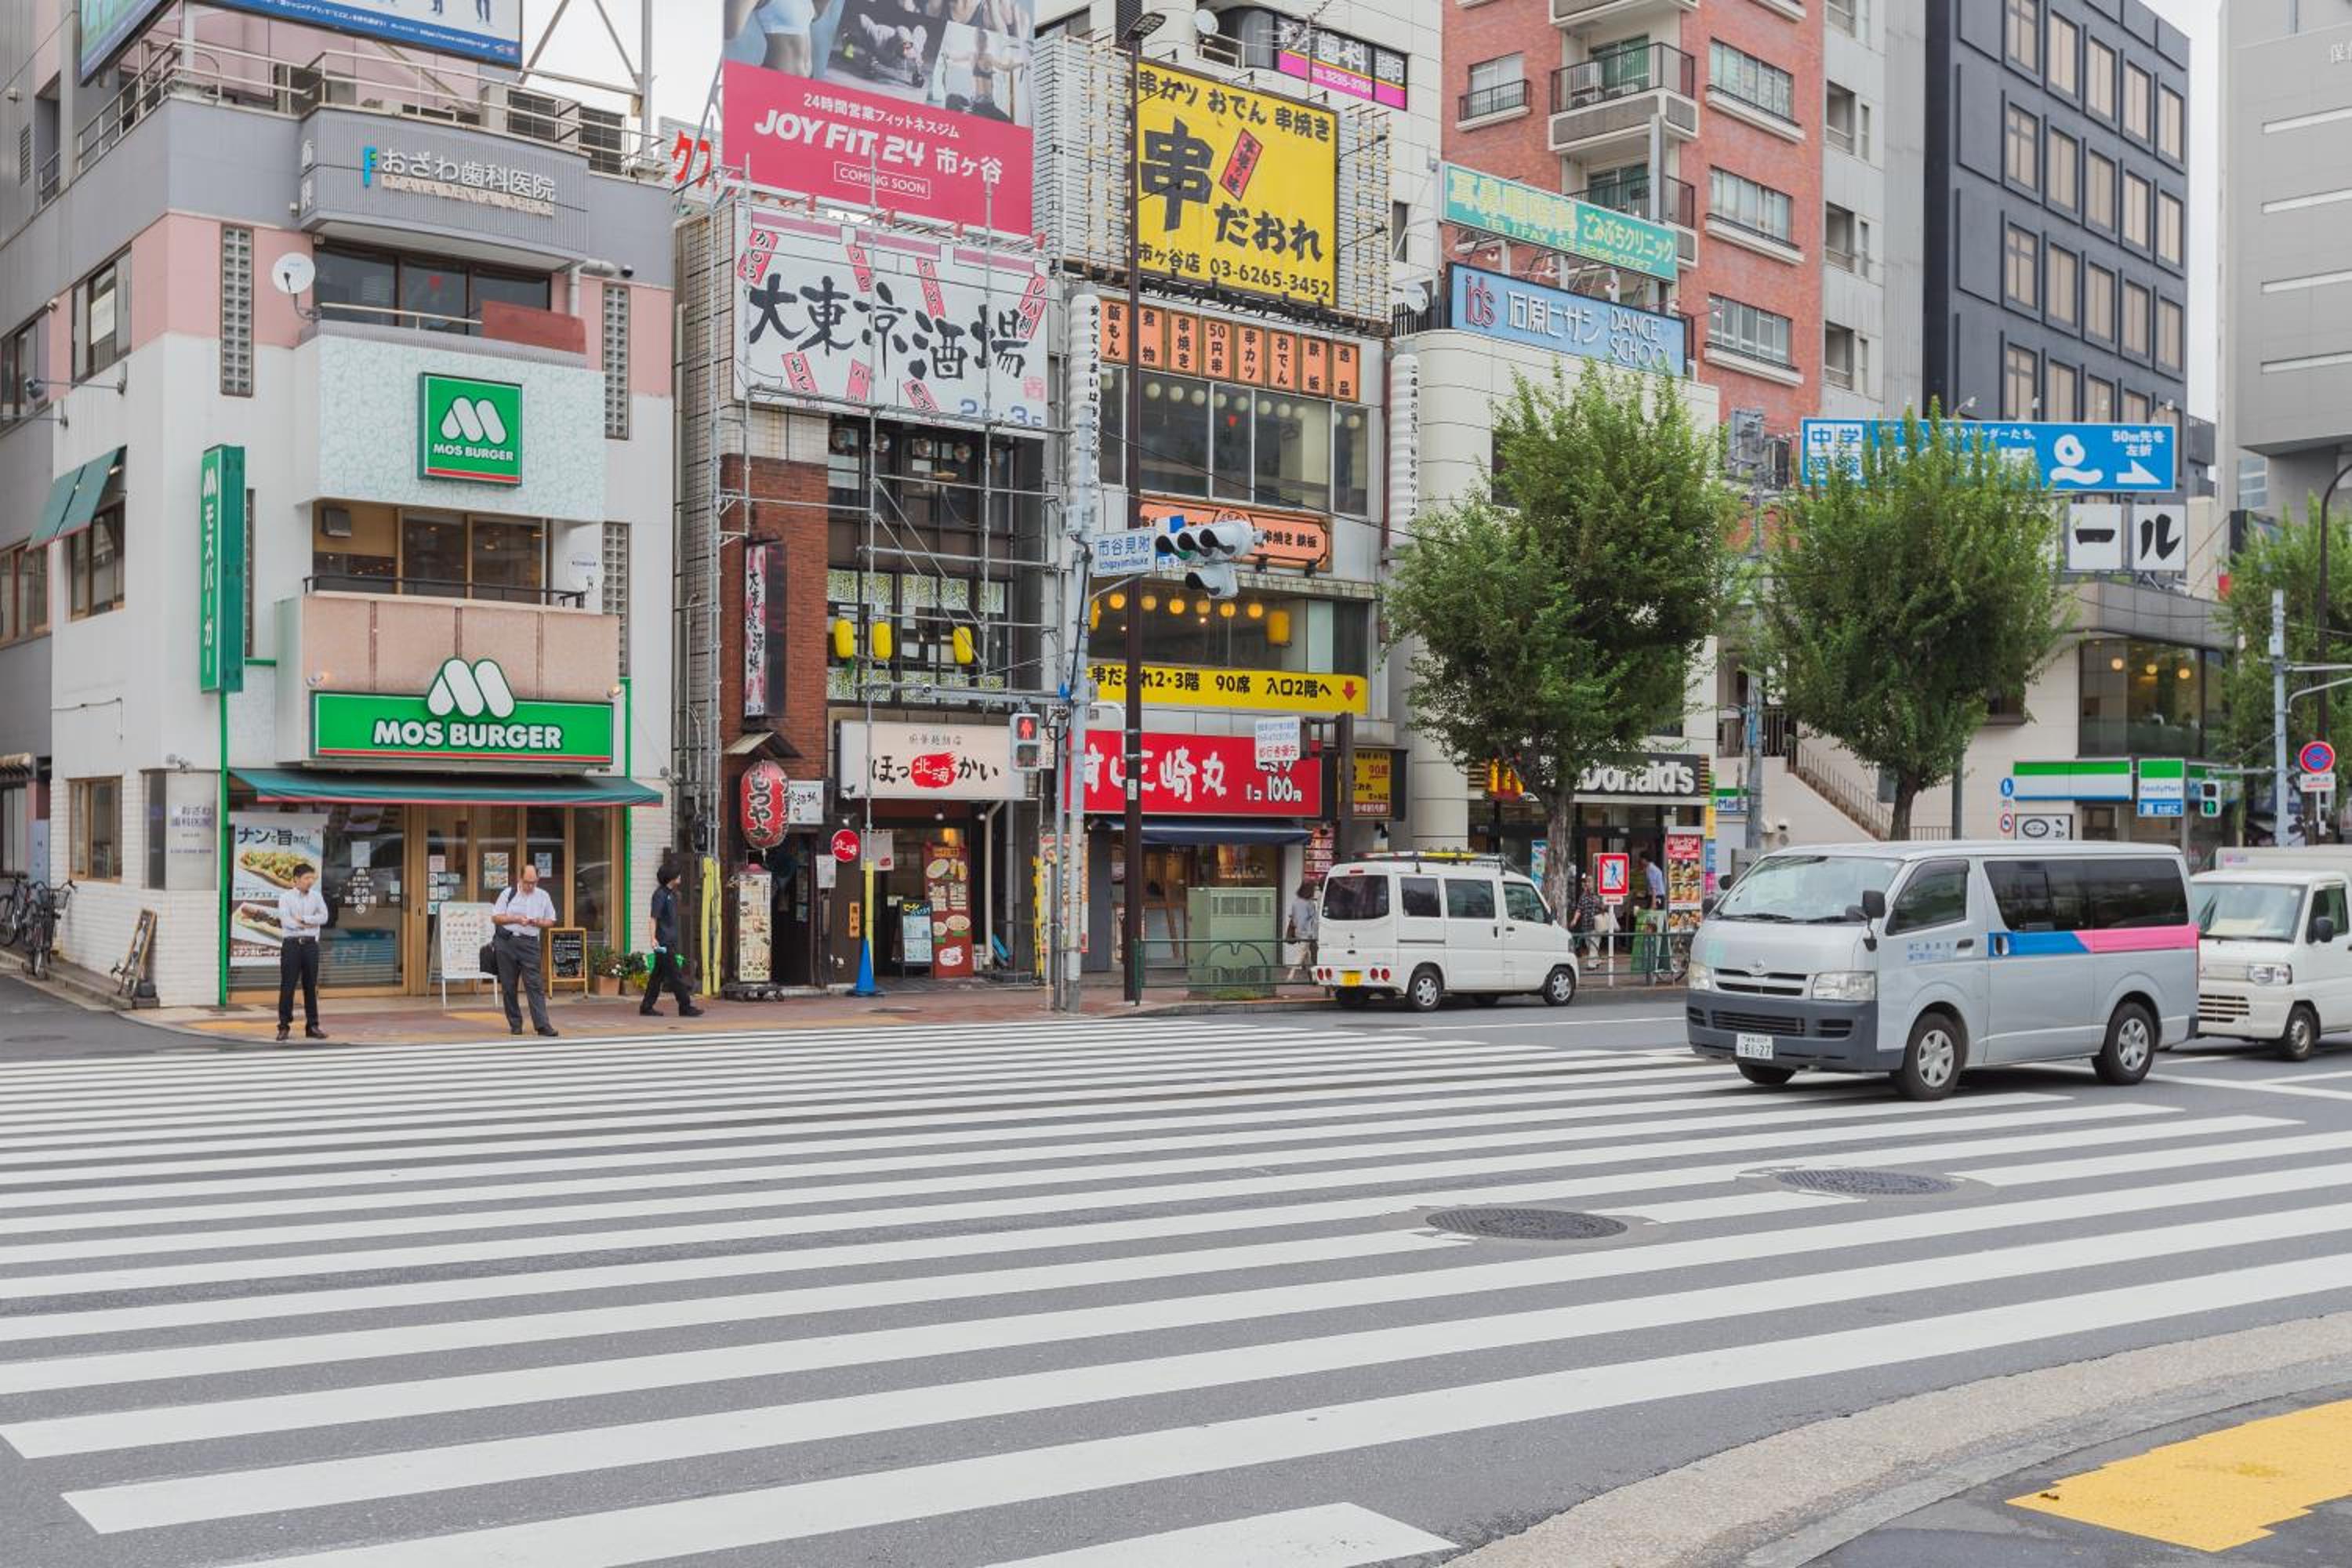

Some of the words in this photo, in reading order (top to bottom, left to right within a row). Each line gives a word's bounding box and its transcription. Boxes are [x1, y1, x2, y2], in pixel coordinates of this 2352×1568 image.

[804, 93, 960, 139] 24時間営業フィットネスジム
[1139, 70, 1199, 107] 串カツ
[1207, 89, 1266, 125] おでん
[1276, 106, 1330, 143] 串焼き
[383, 147, 556, 201] おざわ歯科医院
[840, 167, 888, 187] COMING
[891, 177, 927, 195] SOON
[1139, 117, 1214, 232] 串
[1214, 201, 1323, 263] だおれ
[1210, 258, 1330, 298] 03-6265-3452
[750, 273, 1029, 380] 大東京酒場
[1106, 303, 1121, 358] 飯もん
[1178, 318, 1190, 370] 串焼き
[1209, 323, 1225, 373] 50円串
[1610, 306, 1660, 343] DANCE
[1243, 329, 1256, 379] 串カツ
[1276, 337, 1289, 385] おでん
[433, 444, 463, 458] MOS
[465, 446, 514, 462] BURGER
[2111, 430, 2165, 443] 50m先を
[2125, 445, 2152, 457] 左折
[205, 502, 214, 677] モスバーガー
[1091, 666, 1200, 691] 串だれ2・3階
[1215, 674, 1251, 694] 90席
[1265, 677, 1332, 699] 入口2階へ
[374, 720, 443, 746] MOS
[448, 723, 562, 750] BURGER
